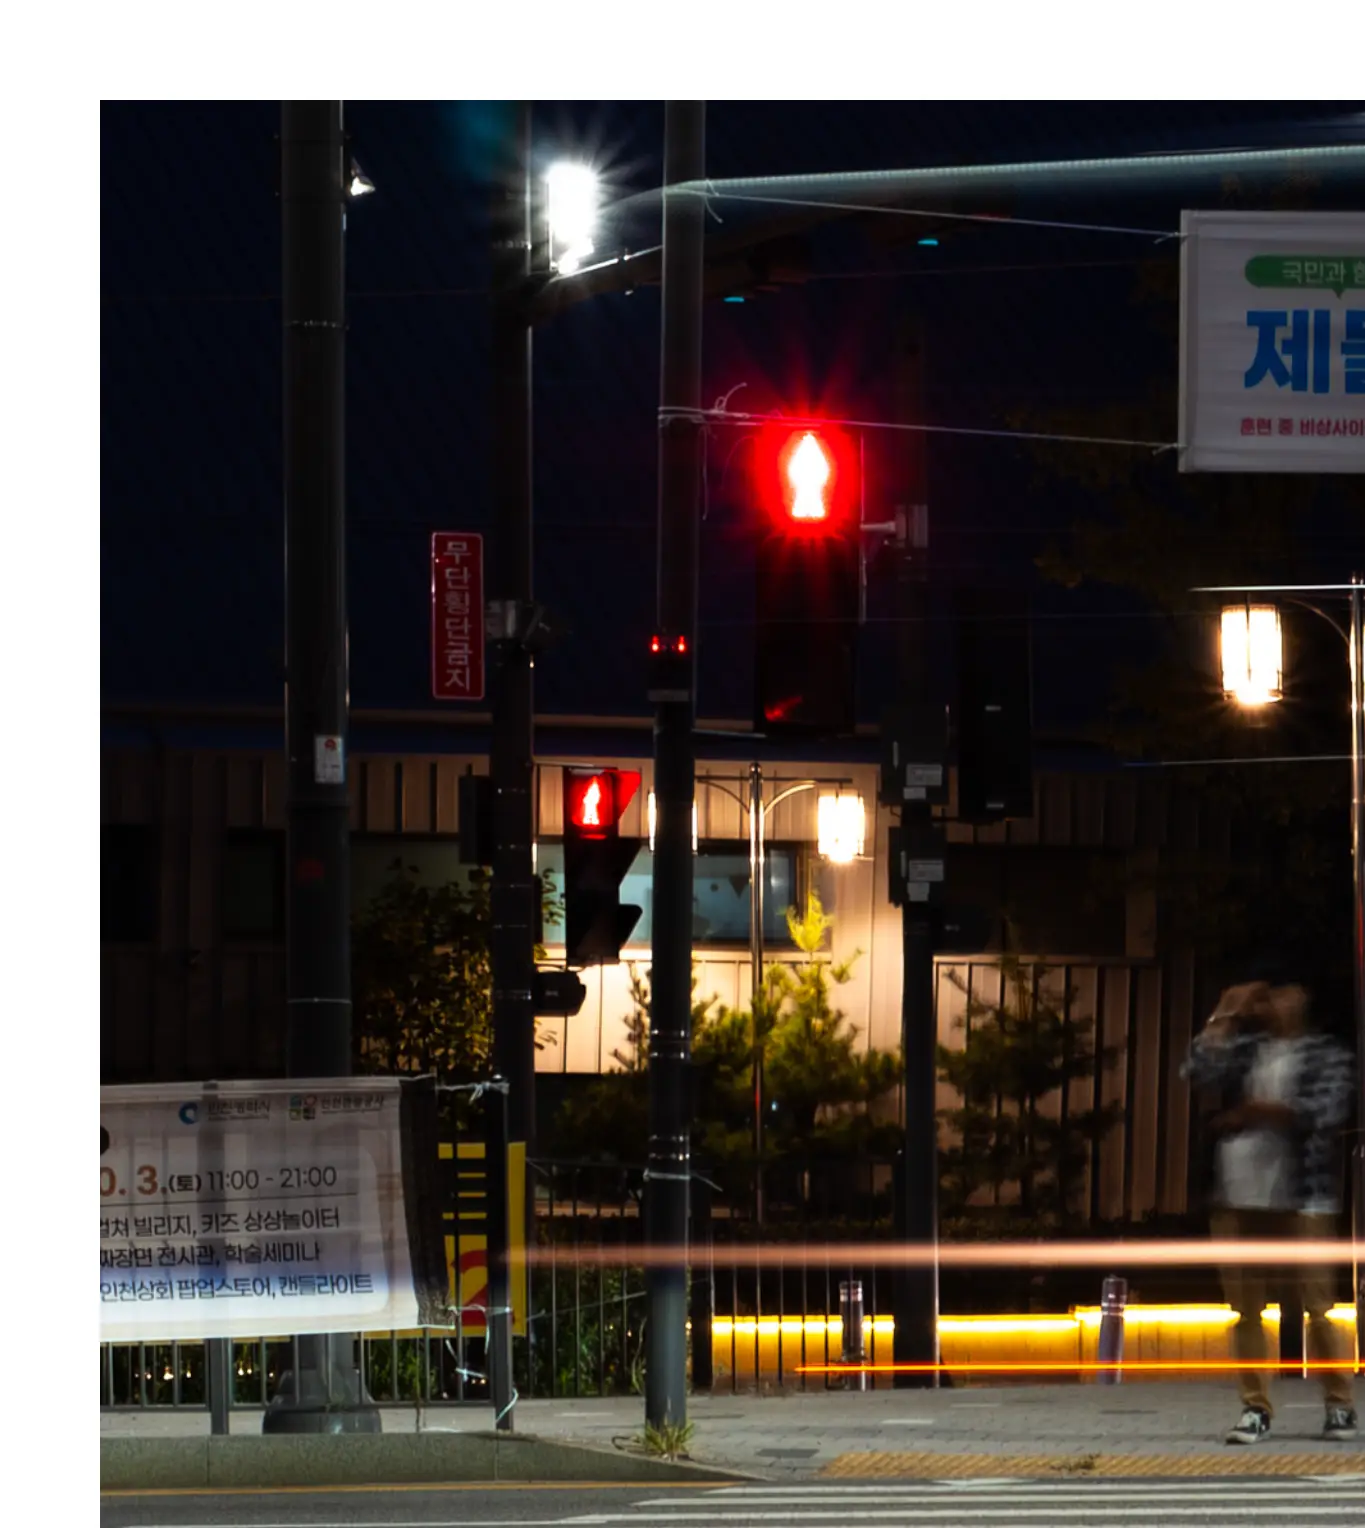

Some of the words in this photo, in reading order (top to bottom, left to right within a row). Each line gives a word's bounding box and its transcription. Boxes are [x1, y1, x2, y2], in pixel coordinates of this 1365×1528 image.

[1282, 260, 1346, 285] 국민과
[1240, 417, 1273, 437] 훈련
[1278, 417, 1294, 437] 중
[443, 541, 474, 692] 무단횡단금지
[207, 1170, 260, 1191] 11:00
[280, 1166, 337, 1188] 21:00
[134, 1215, 197, 1239] 빌리지,
[201, 1212, 241, 1234] 키즈
[243, 1206, 340, 1233] 상상놀이터
[156, 1244, 220, 1268] 전시관,
[223, 1241, 321, 1264] 학술세미나
[176, 1276, 276, 1300] 팝업스토어,
[279, 1273, 374, 1297] 캔들라이트
